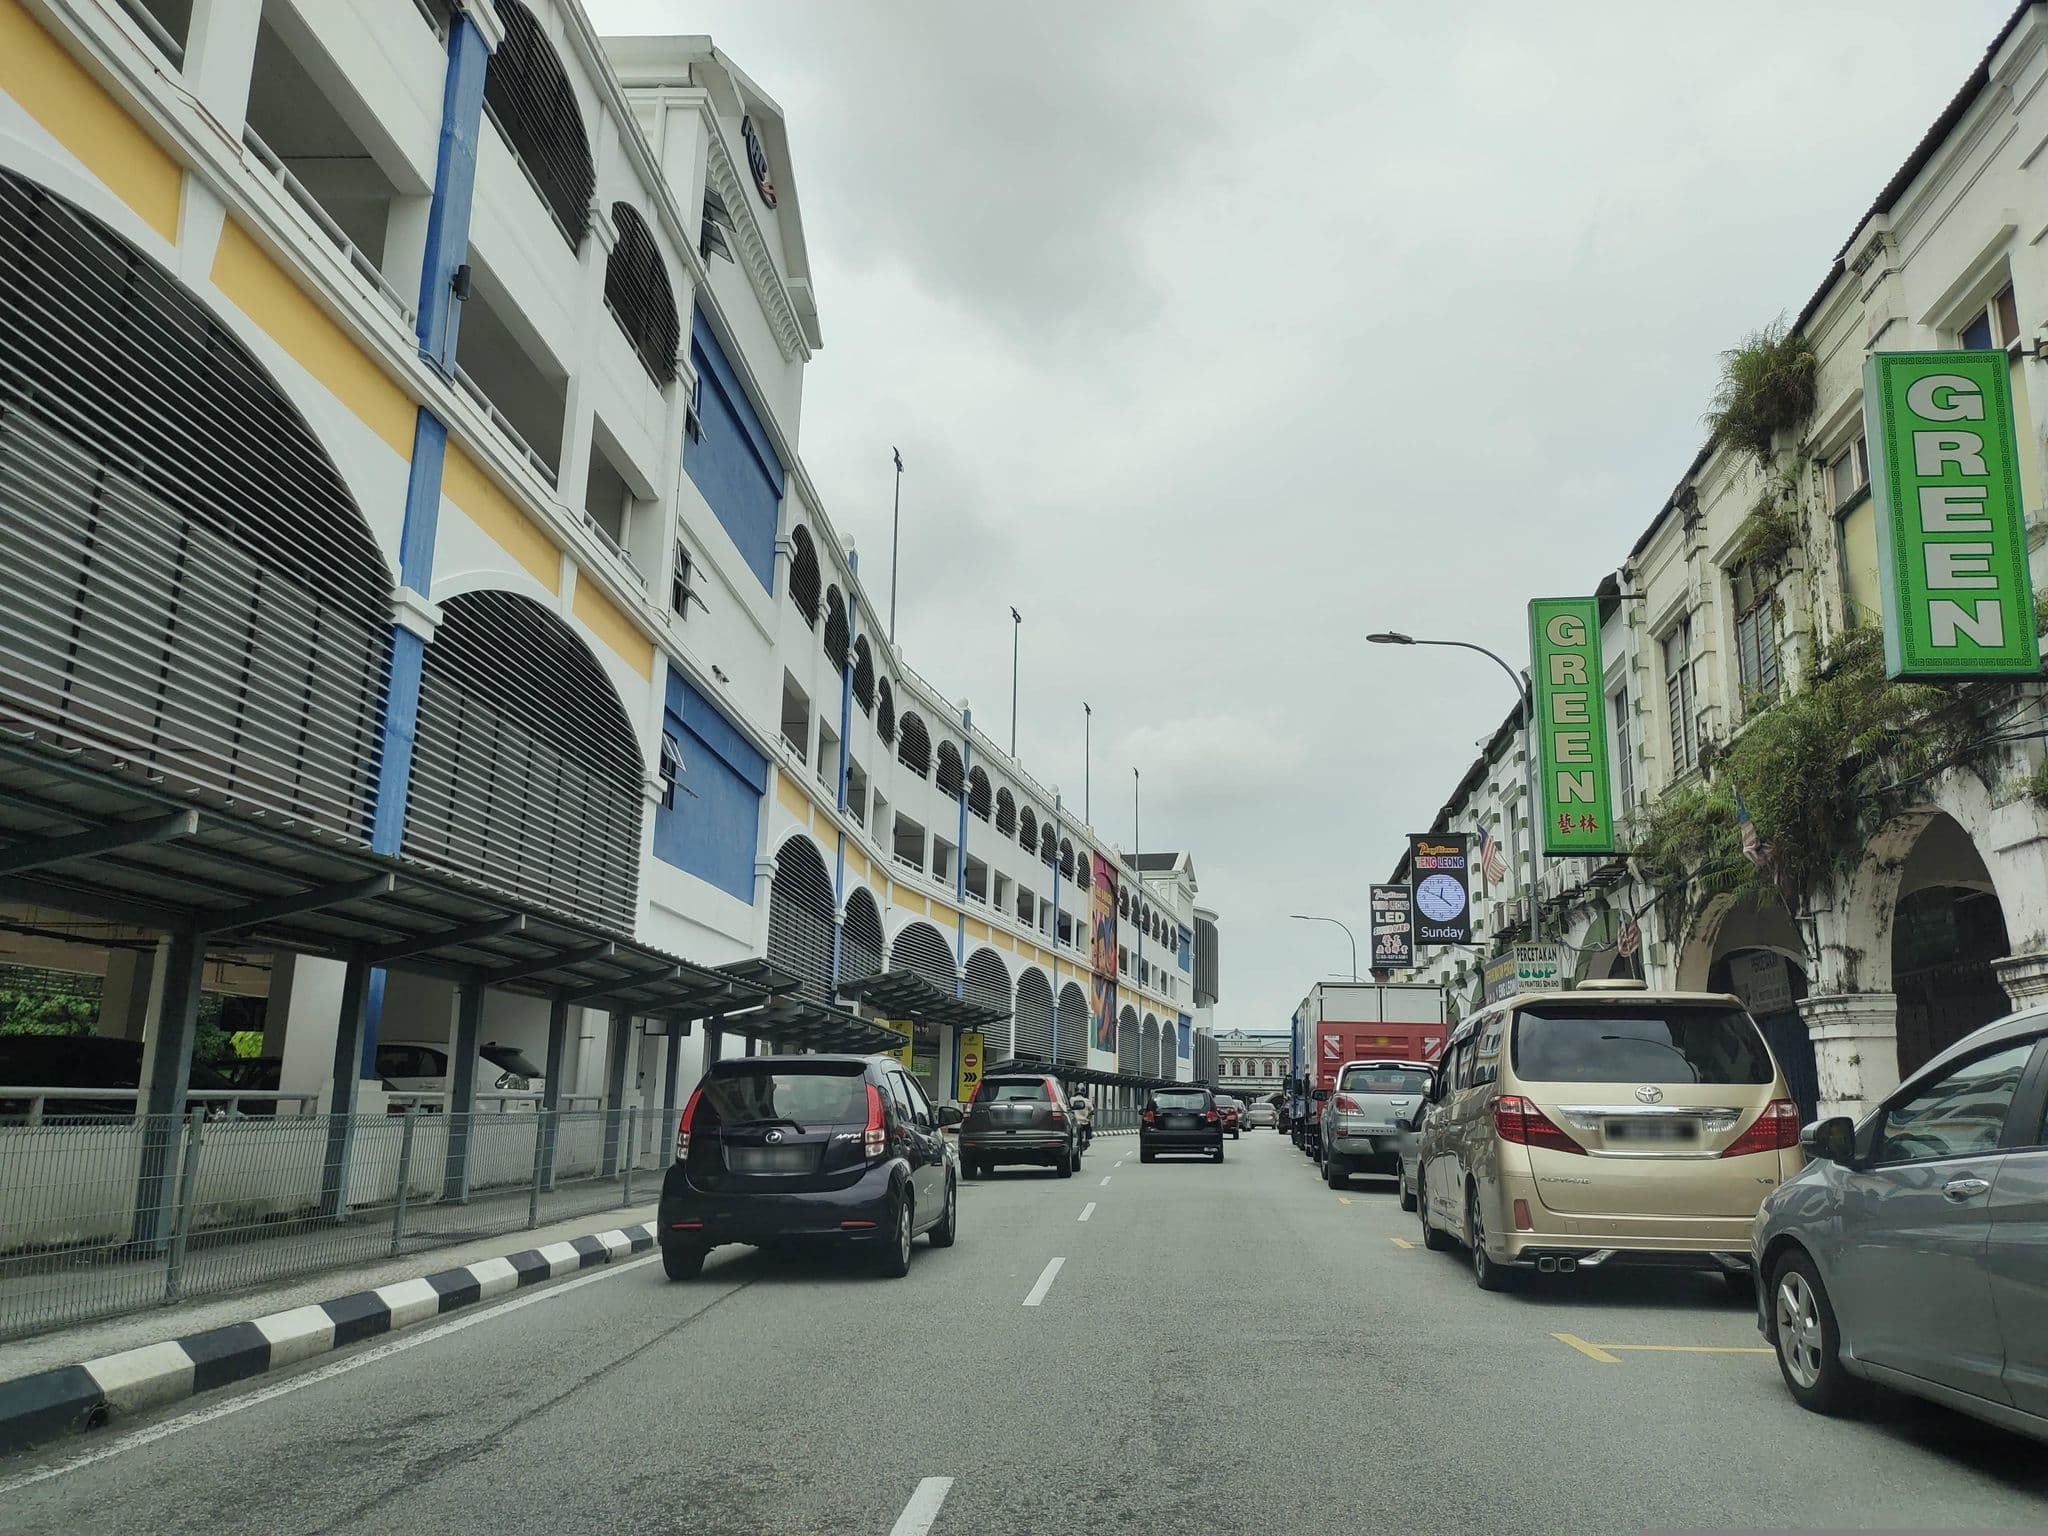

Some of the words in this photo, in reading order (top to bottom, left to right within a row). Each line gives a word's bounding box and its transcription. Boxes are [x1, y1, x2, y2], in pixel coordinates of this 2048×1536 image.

[1906, 374, 2006, 648] GREEN
[1546, 614, 1597, 804] GREEN
[1437, 856, 1464, 868] LEONG
[1376, 911, 1405, 923] LED
[1421, 926, 1464, 940] Sunday
[1516, 947, 1557, 961] PERCETAKAN
